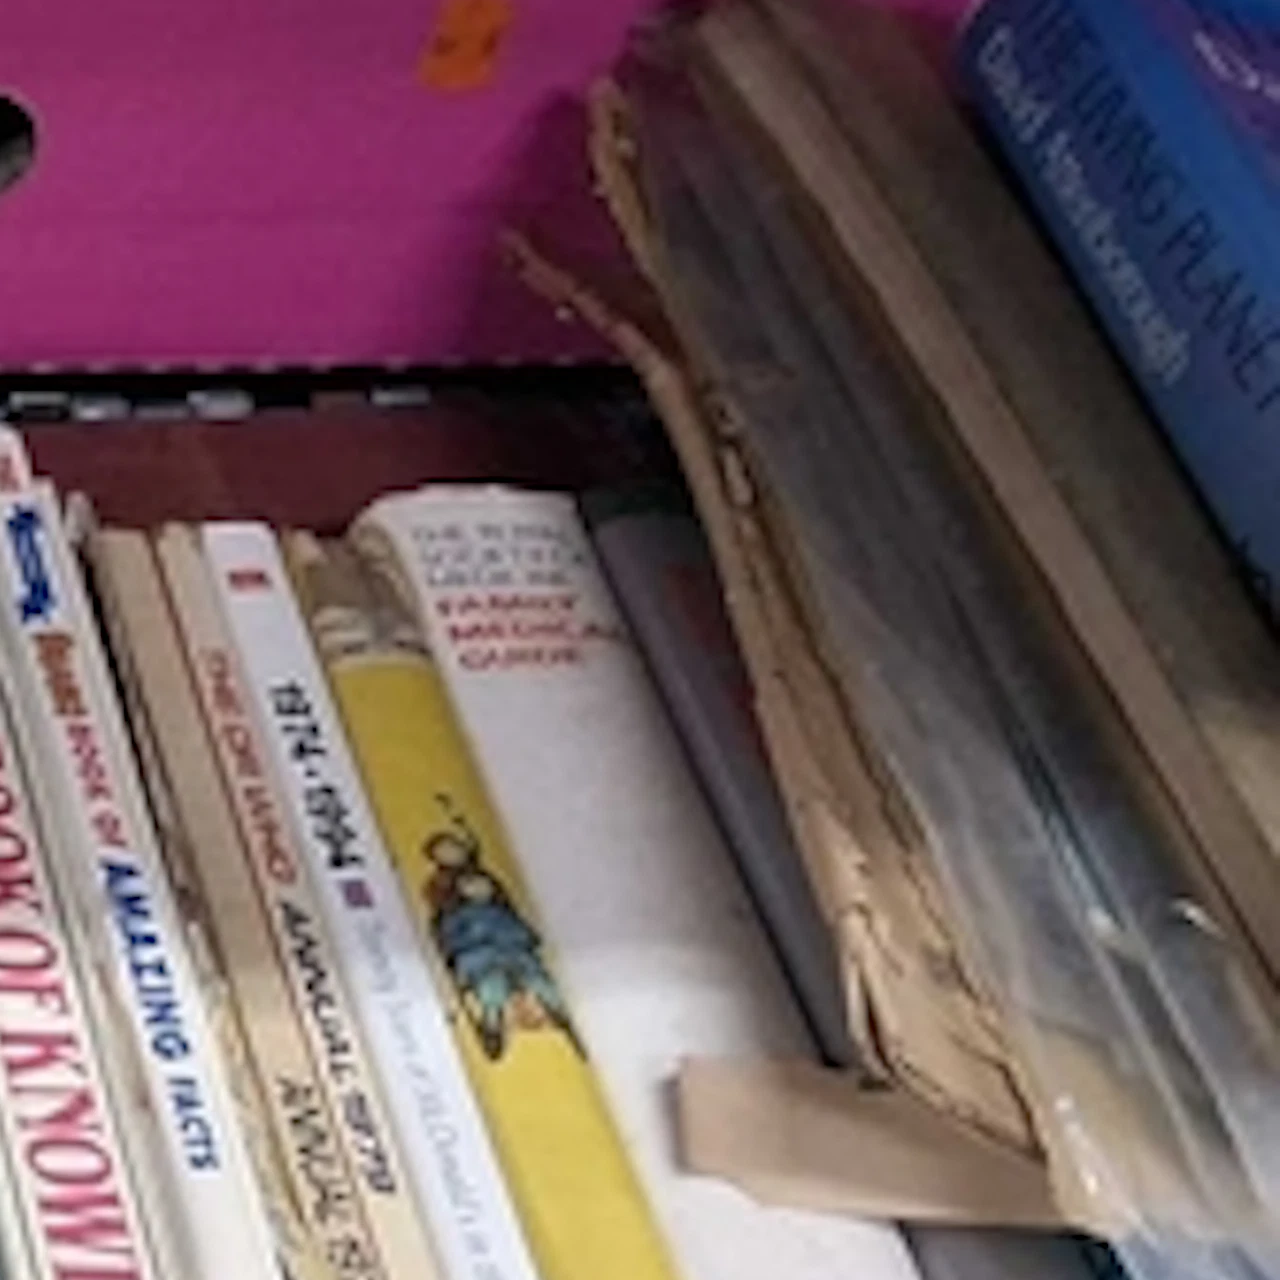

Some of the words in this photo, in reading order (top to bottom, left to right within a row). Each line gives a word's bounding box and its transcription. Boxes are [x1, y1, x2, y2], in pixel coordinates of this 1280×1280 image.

[100, 856, 192, 1061] AMAZING
[167, 1076, 221, 1172] FACTS
[279, 898, 356, 1078] ANNUAL
